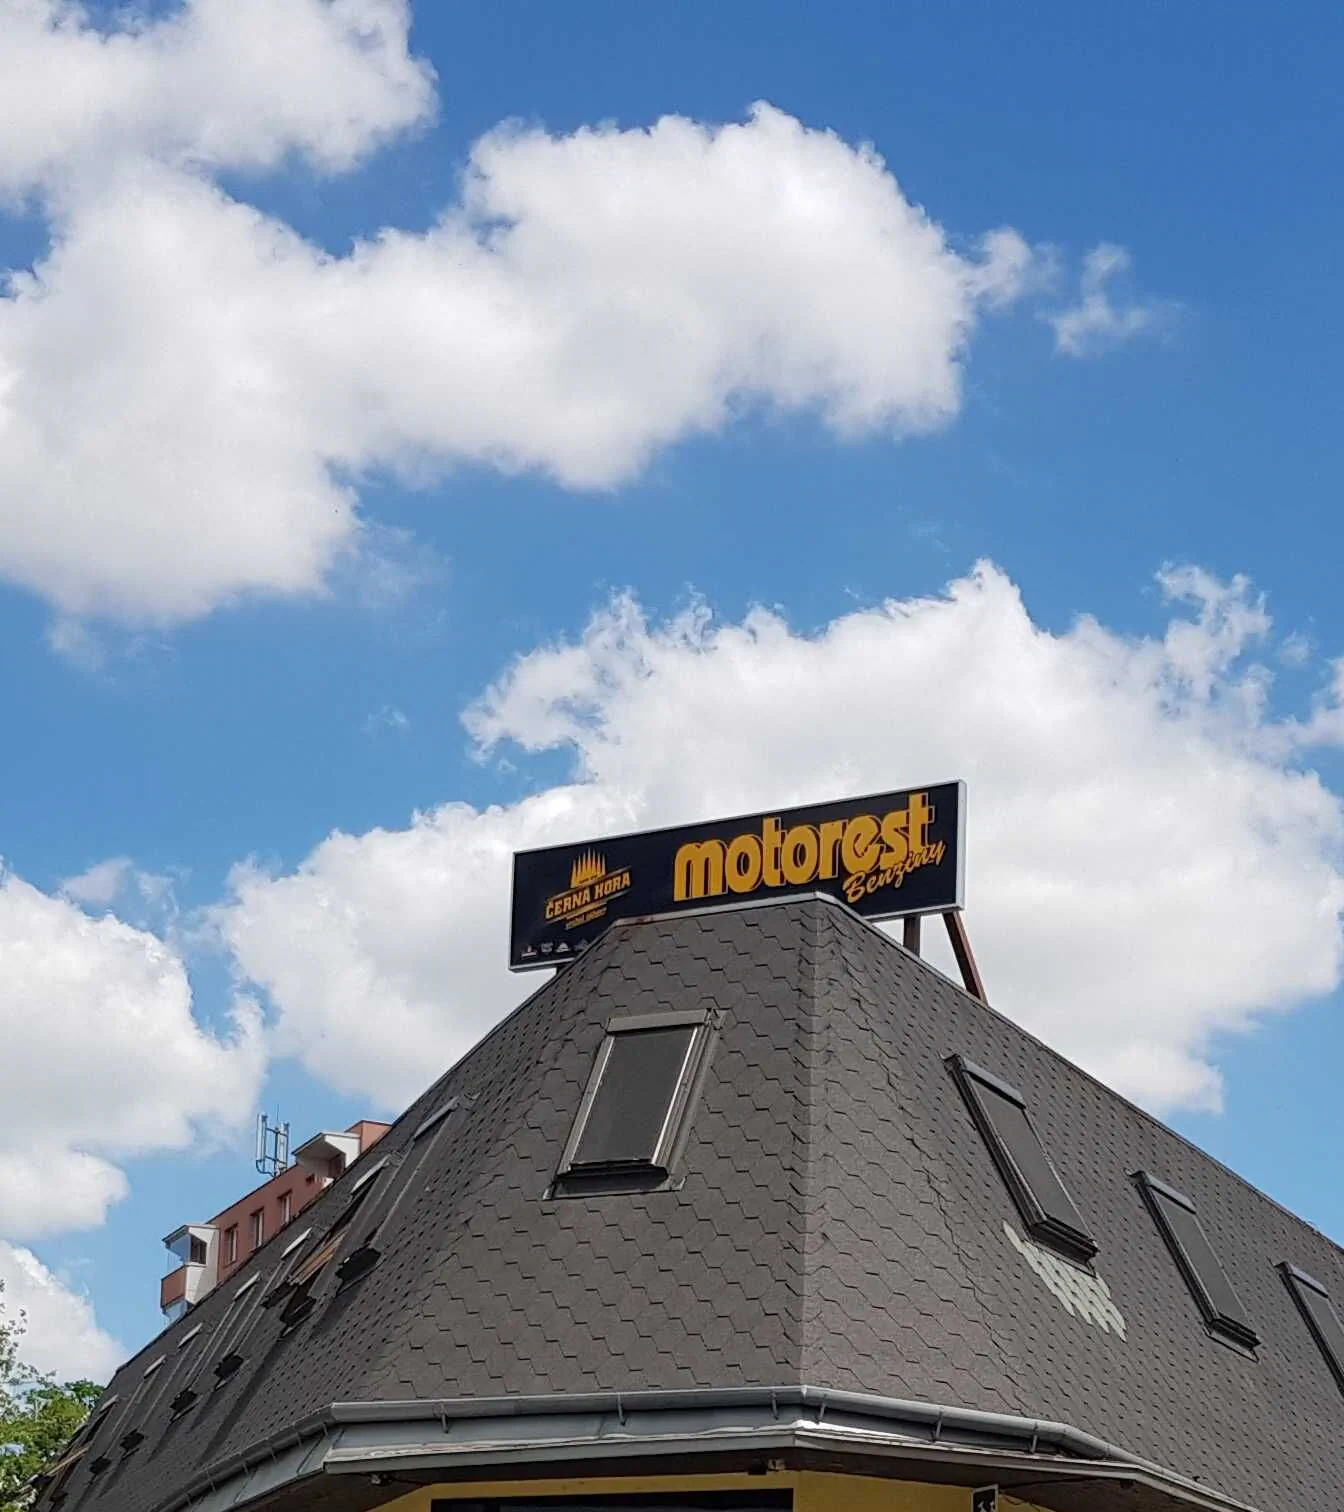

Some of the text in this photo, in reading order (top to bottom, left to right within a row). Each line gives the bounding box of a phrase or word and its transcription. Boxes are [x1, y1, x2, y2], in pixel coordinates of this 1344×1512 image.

[673, 792, 935, 902] motorest
[842, 840, 946, 903] Benziny
[593, 871, 631, 900] HORA
